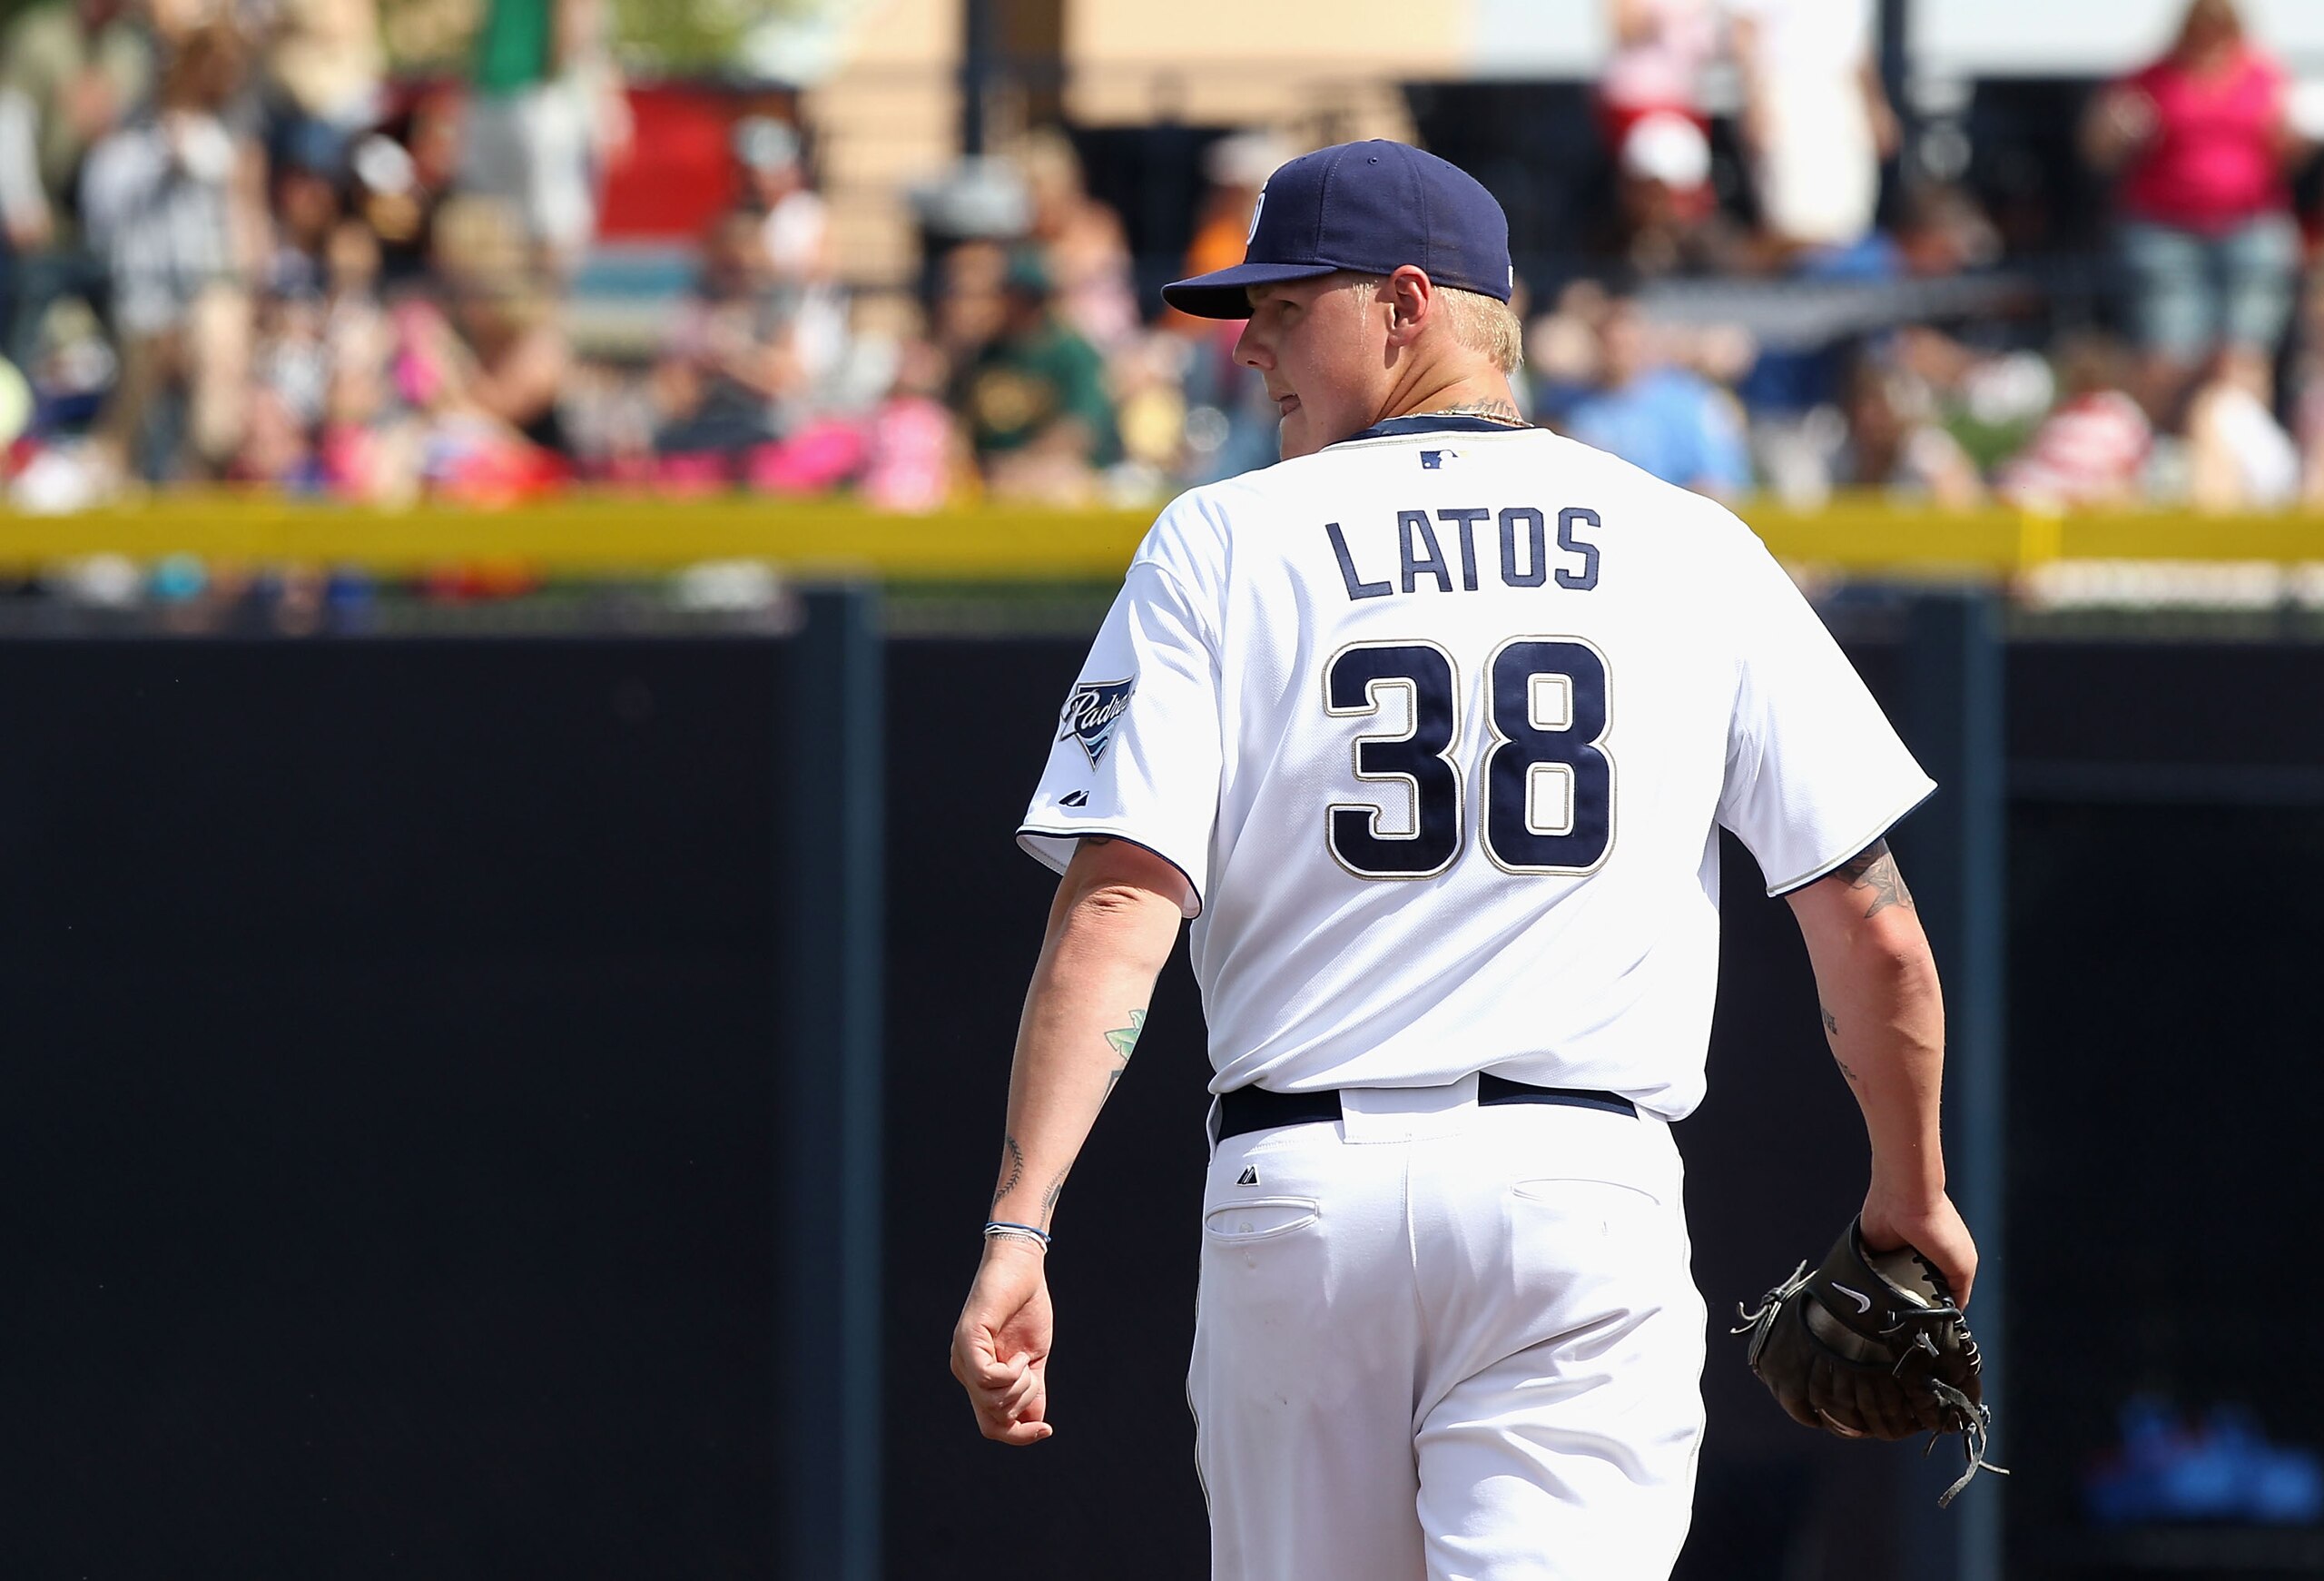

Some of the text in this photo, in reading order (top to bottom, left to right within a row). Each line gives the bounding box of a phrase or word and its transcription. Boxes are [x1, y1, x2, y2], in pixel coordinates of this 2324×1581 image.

[1324, 507, 1601, 601] LATOS
[1058, 687, 1130, 743] Padre
[1320, 634, 1618, 882] 38
